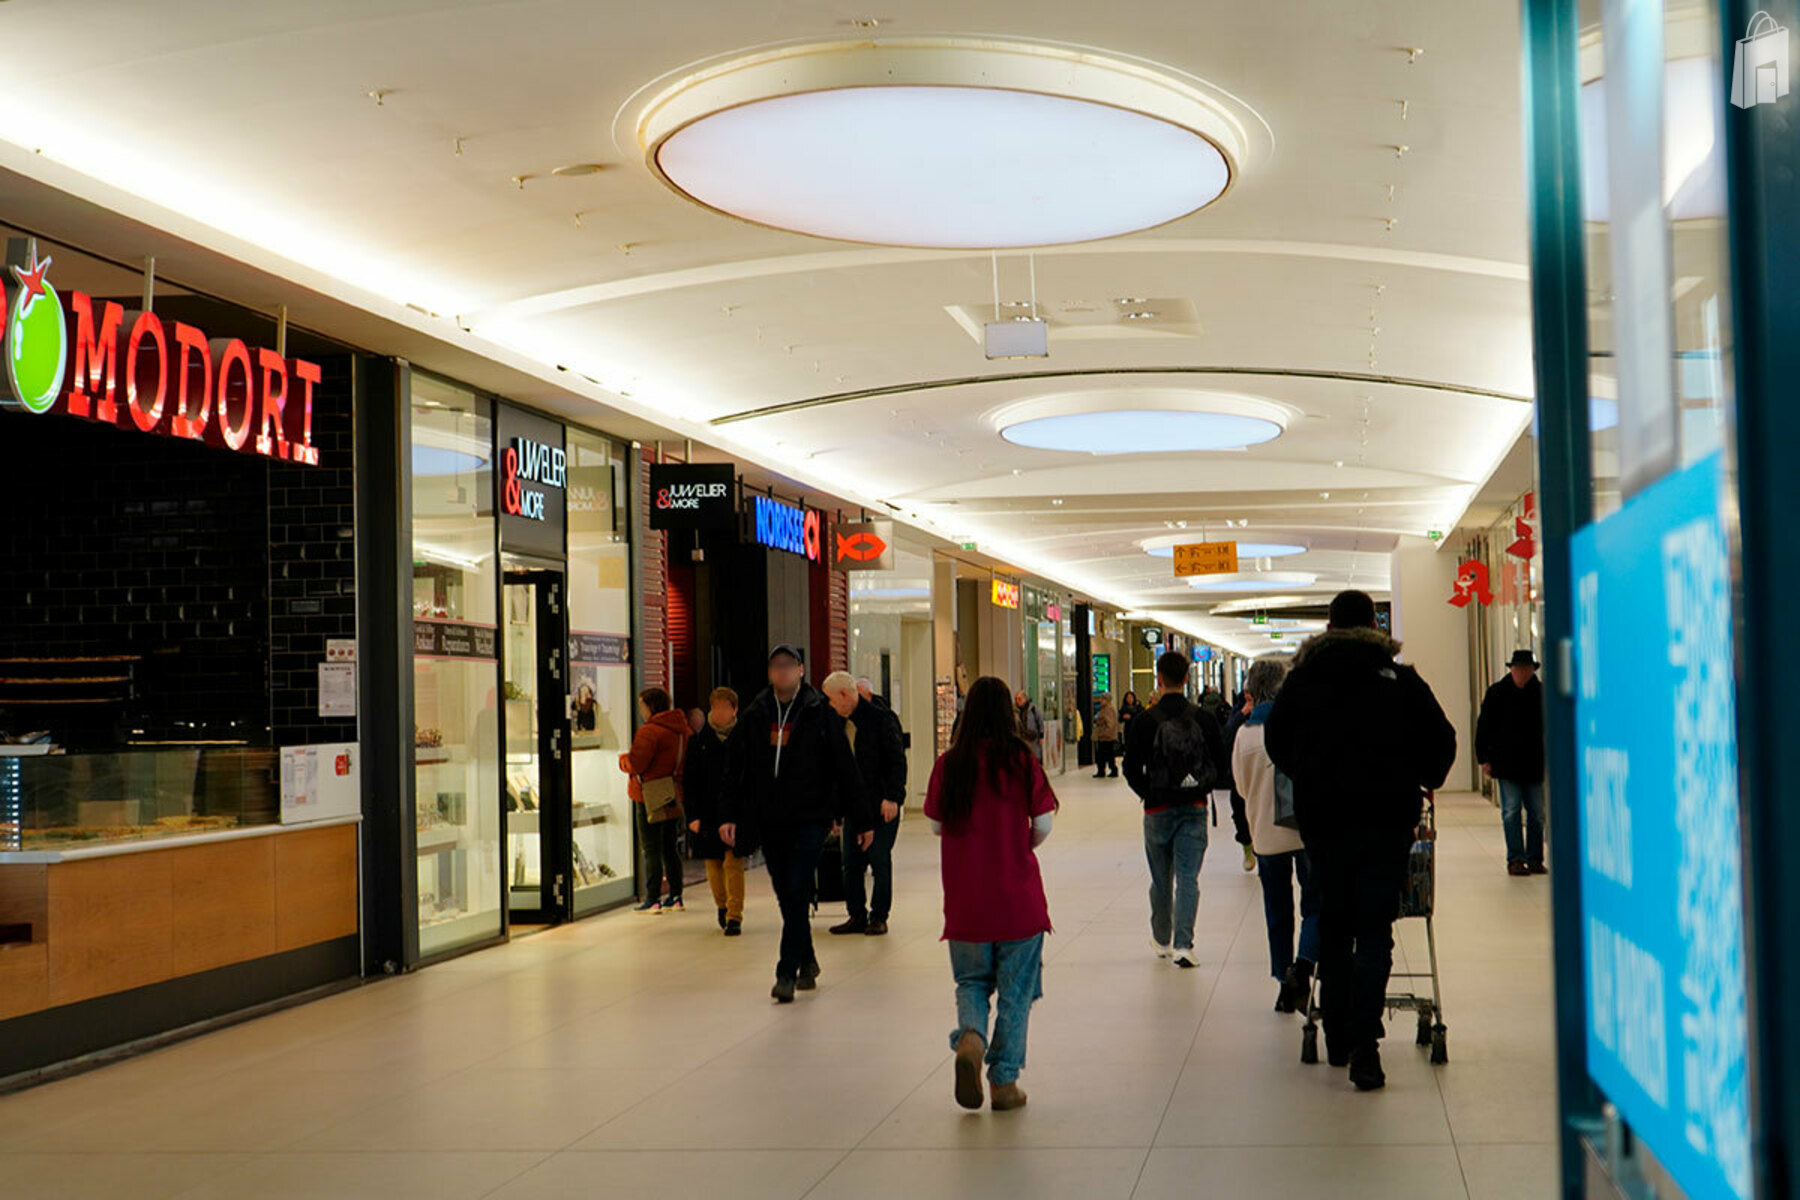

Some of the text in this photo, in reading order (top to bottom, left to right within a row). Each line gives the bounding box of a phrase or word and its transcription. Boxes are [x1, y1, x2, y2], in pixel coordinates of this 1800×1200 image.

[505, 447, 545, 521] & MORE
[656, 488, 700, 509] & MORE
[669, 483, 727, 498] JUWELIER
[755, 495, 806, 555] NORDSEE
